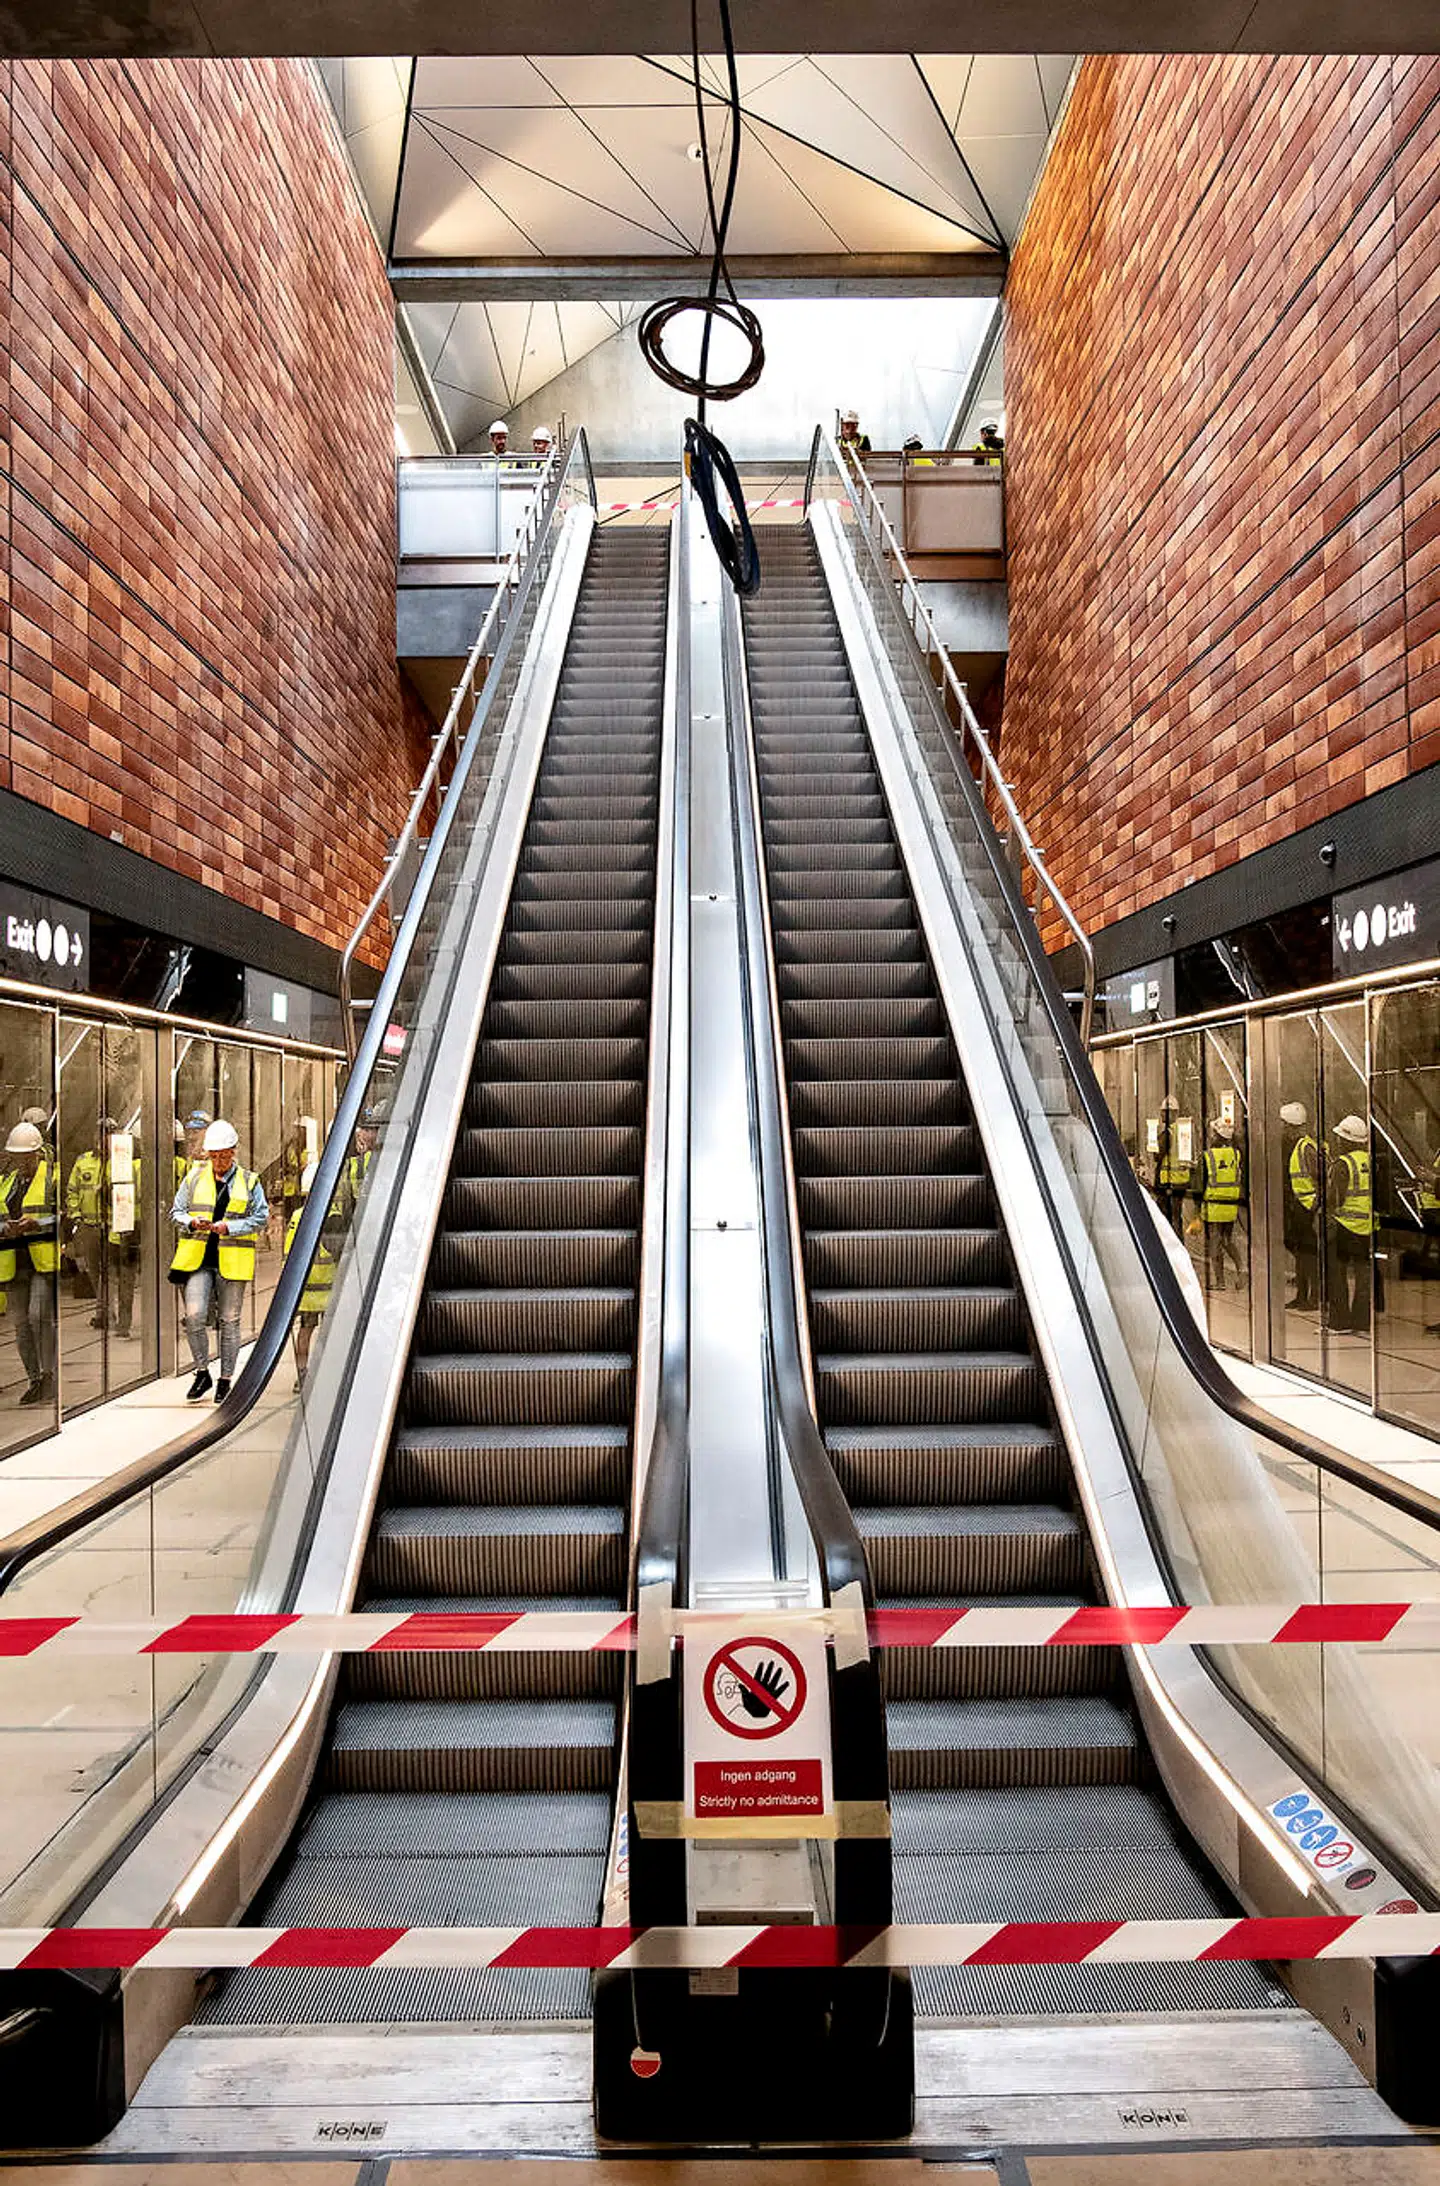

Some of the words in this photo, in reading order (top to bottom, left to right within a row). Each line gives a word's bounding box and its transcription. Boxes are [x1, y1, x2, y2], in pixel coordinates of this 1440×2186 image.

[1388, 901, 1416, 938] Exit
[7, 915, 35, 953] Exit
[720, 1769, 752, 1784] Ingen
[755, 1769, 796, 1782] adgang
[700, 1795, 738, 1810] Strictly
[740, 1796, 755, 1807] no
[757, 1794, 819, 1806] admittance
[1122, 2112, 1188, 2126] KONE
[318, 2124, 384, 2138] KONE
